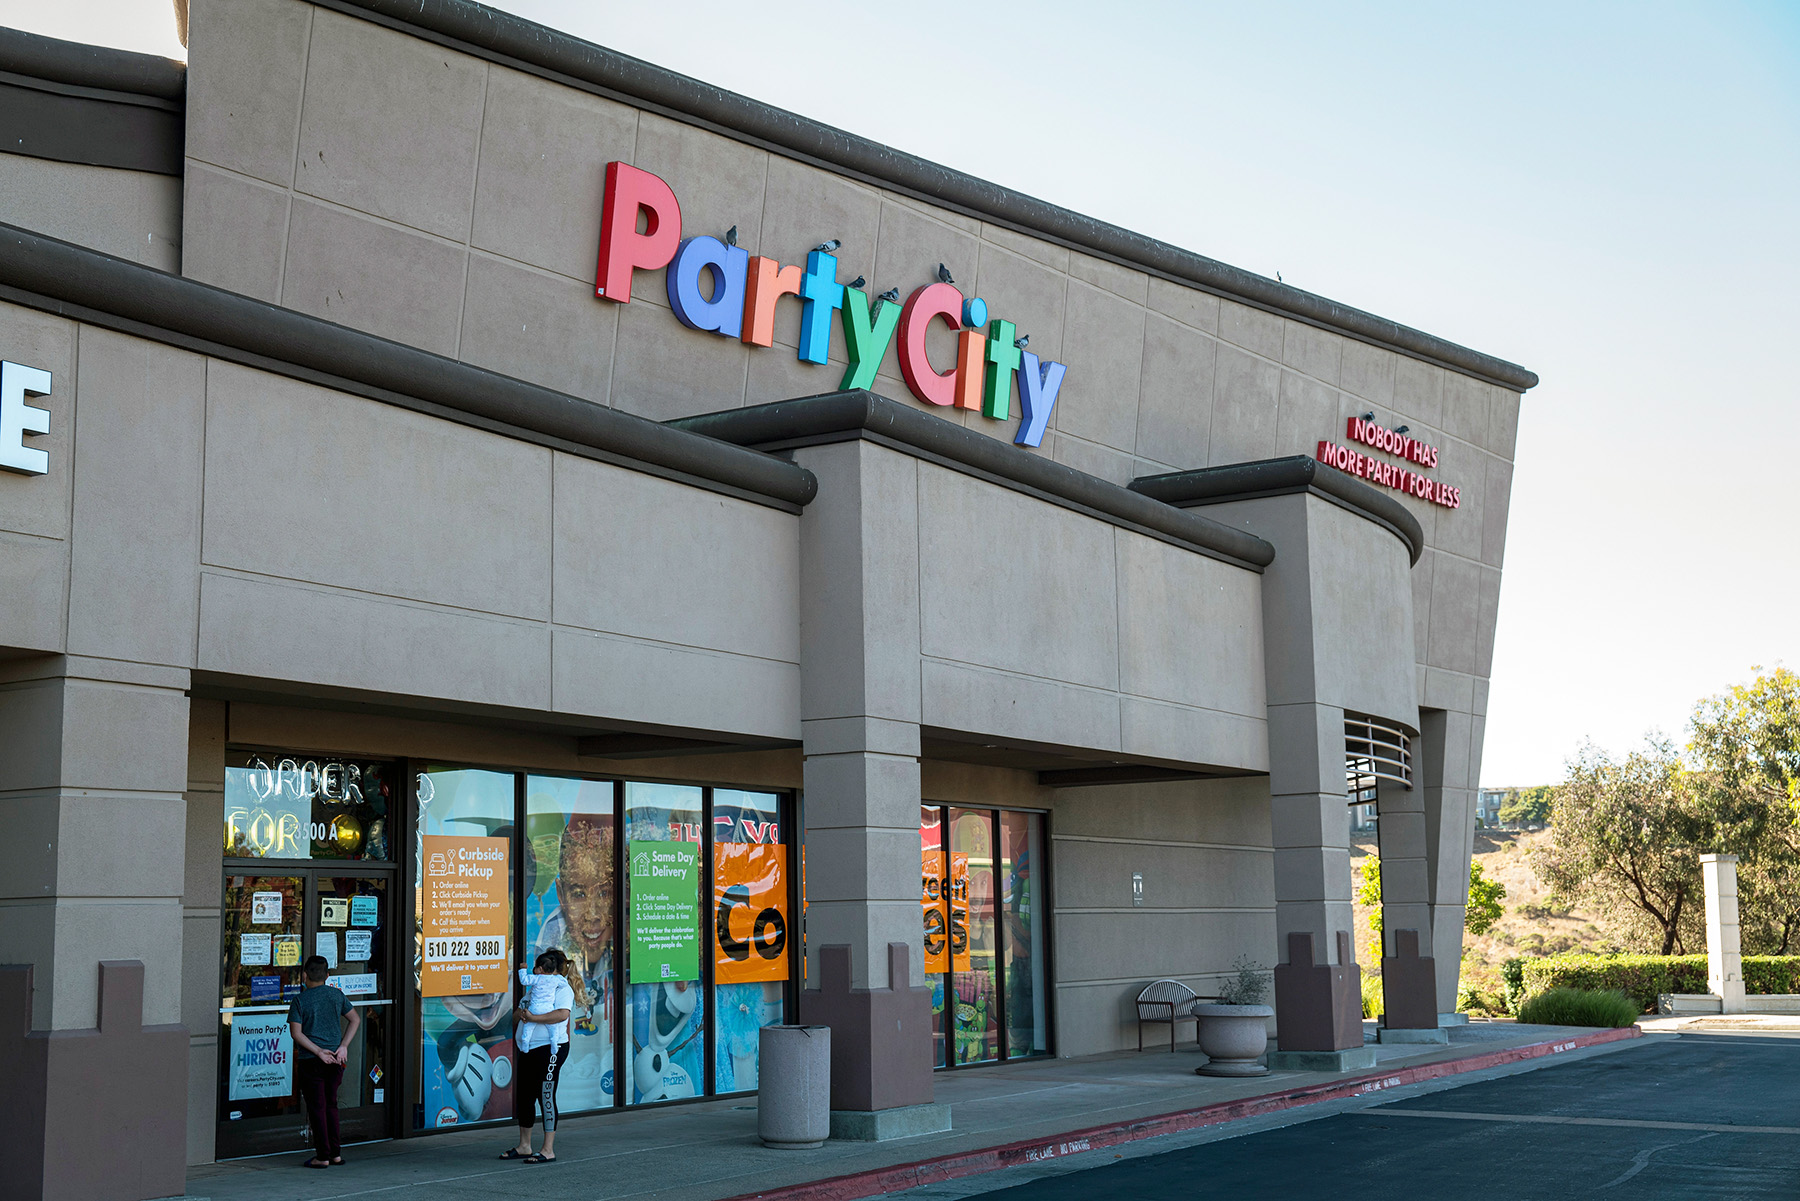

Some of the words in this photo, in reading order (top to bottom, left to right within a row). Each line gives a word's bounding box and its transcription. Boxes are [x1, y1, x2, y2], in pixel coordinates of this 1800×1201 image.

[1348, 417, 1411, 457] NOBODY
[1412, 440, 1438, 468] HAS
[1318, 441, 1364, 476] MORE
[1365, 456, 1407, 493] PARTY
[1408, 472, 1434, 501] FOR
[1435, 482, 1460, 509] LESS
[246, 754, 364, 804] ORDER
[328, 823, 338, 841] A
[458, 847, 504, 861] Curbside
[652, 851, 675, 862] Same
[678, 851, 694, 866] Day
[458, 863, 494, 880] Pickup
[652, 865, 687, 880] Delivery
[432, 881, 438, 889] 1.
[439, 881, 453, 889] Order
[454, 881, 469, 889] online
[473, 891, 488, 900] Pickup
[439, 900, 451, 908] We'll
[452, 900, 465, 908] email
[476, 900, 489, 908] when
[666, 903, 675, 912] Day
[676, 903, 693, 912] Delivery
[457, 908, 471, 917] ready
[642, 912, 661, 920] Schedule
[666, 912, 675, 920] date
[477, 917, 490, 925] when
[716, 884, 786, 962] Co
[429, 941, 447, 957] 510
[451, 941, 469, 956] 222
[475, 941, 499, 956] 9880
[661, 941, 675, 950] people
[430, 964, 445, 972] We'll
[238, 1026, 263, 1035] Wanna
[265, 1024, 287, 1035] Party?
[245, 1038, 280, 1052] NOW
[237, 1051, 286, 1066] HIRING!
[663, 1075, 687, 1087] FROZEN
[543, 1082, 554, 1122] sport
[1026, 1149, 1040, 1161] FIRE
[1040, 1146, 1055, 1159] LANE
[1060, 1143, 1069, 1154] NO
[1069, 1139, 1090, 1153] PARKING
